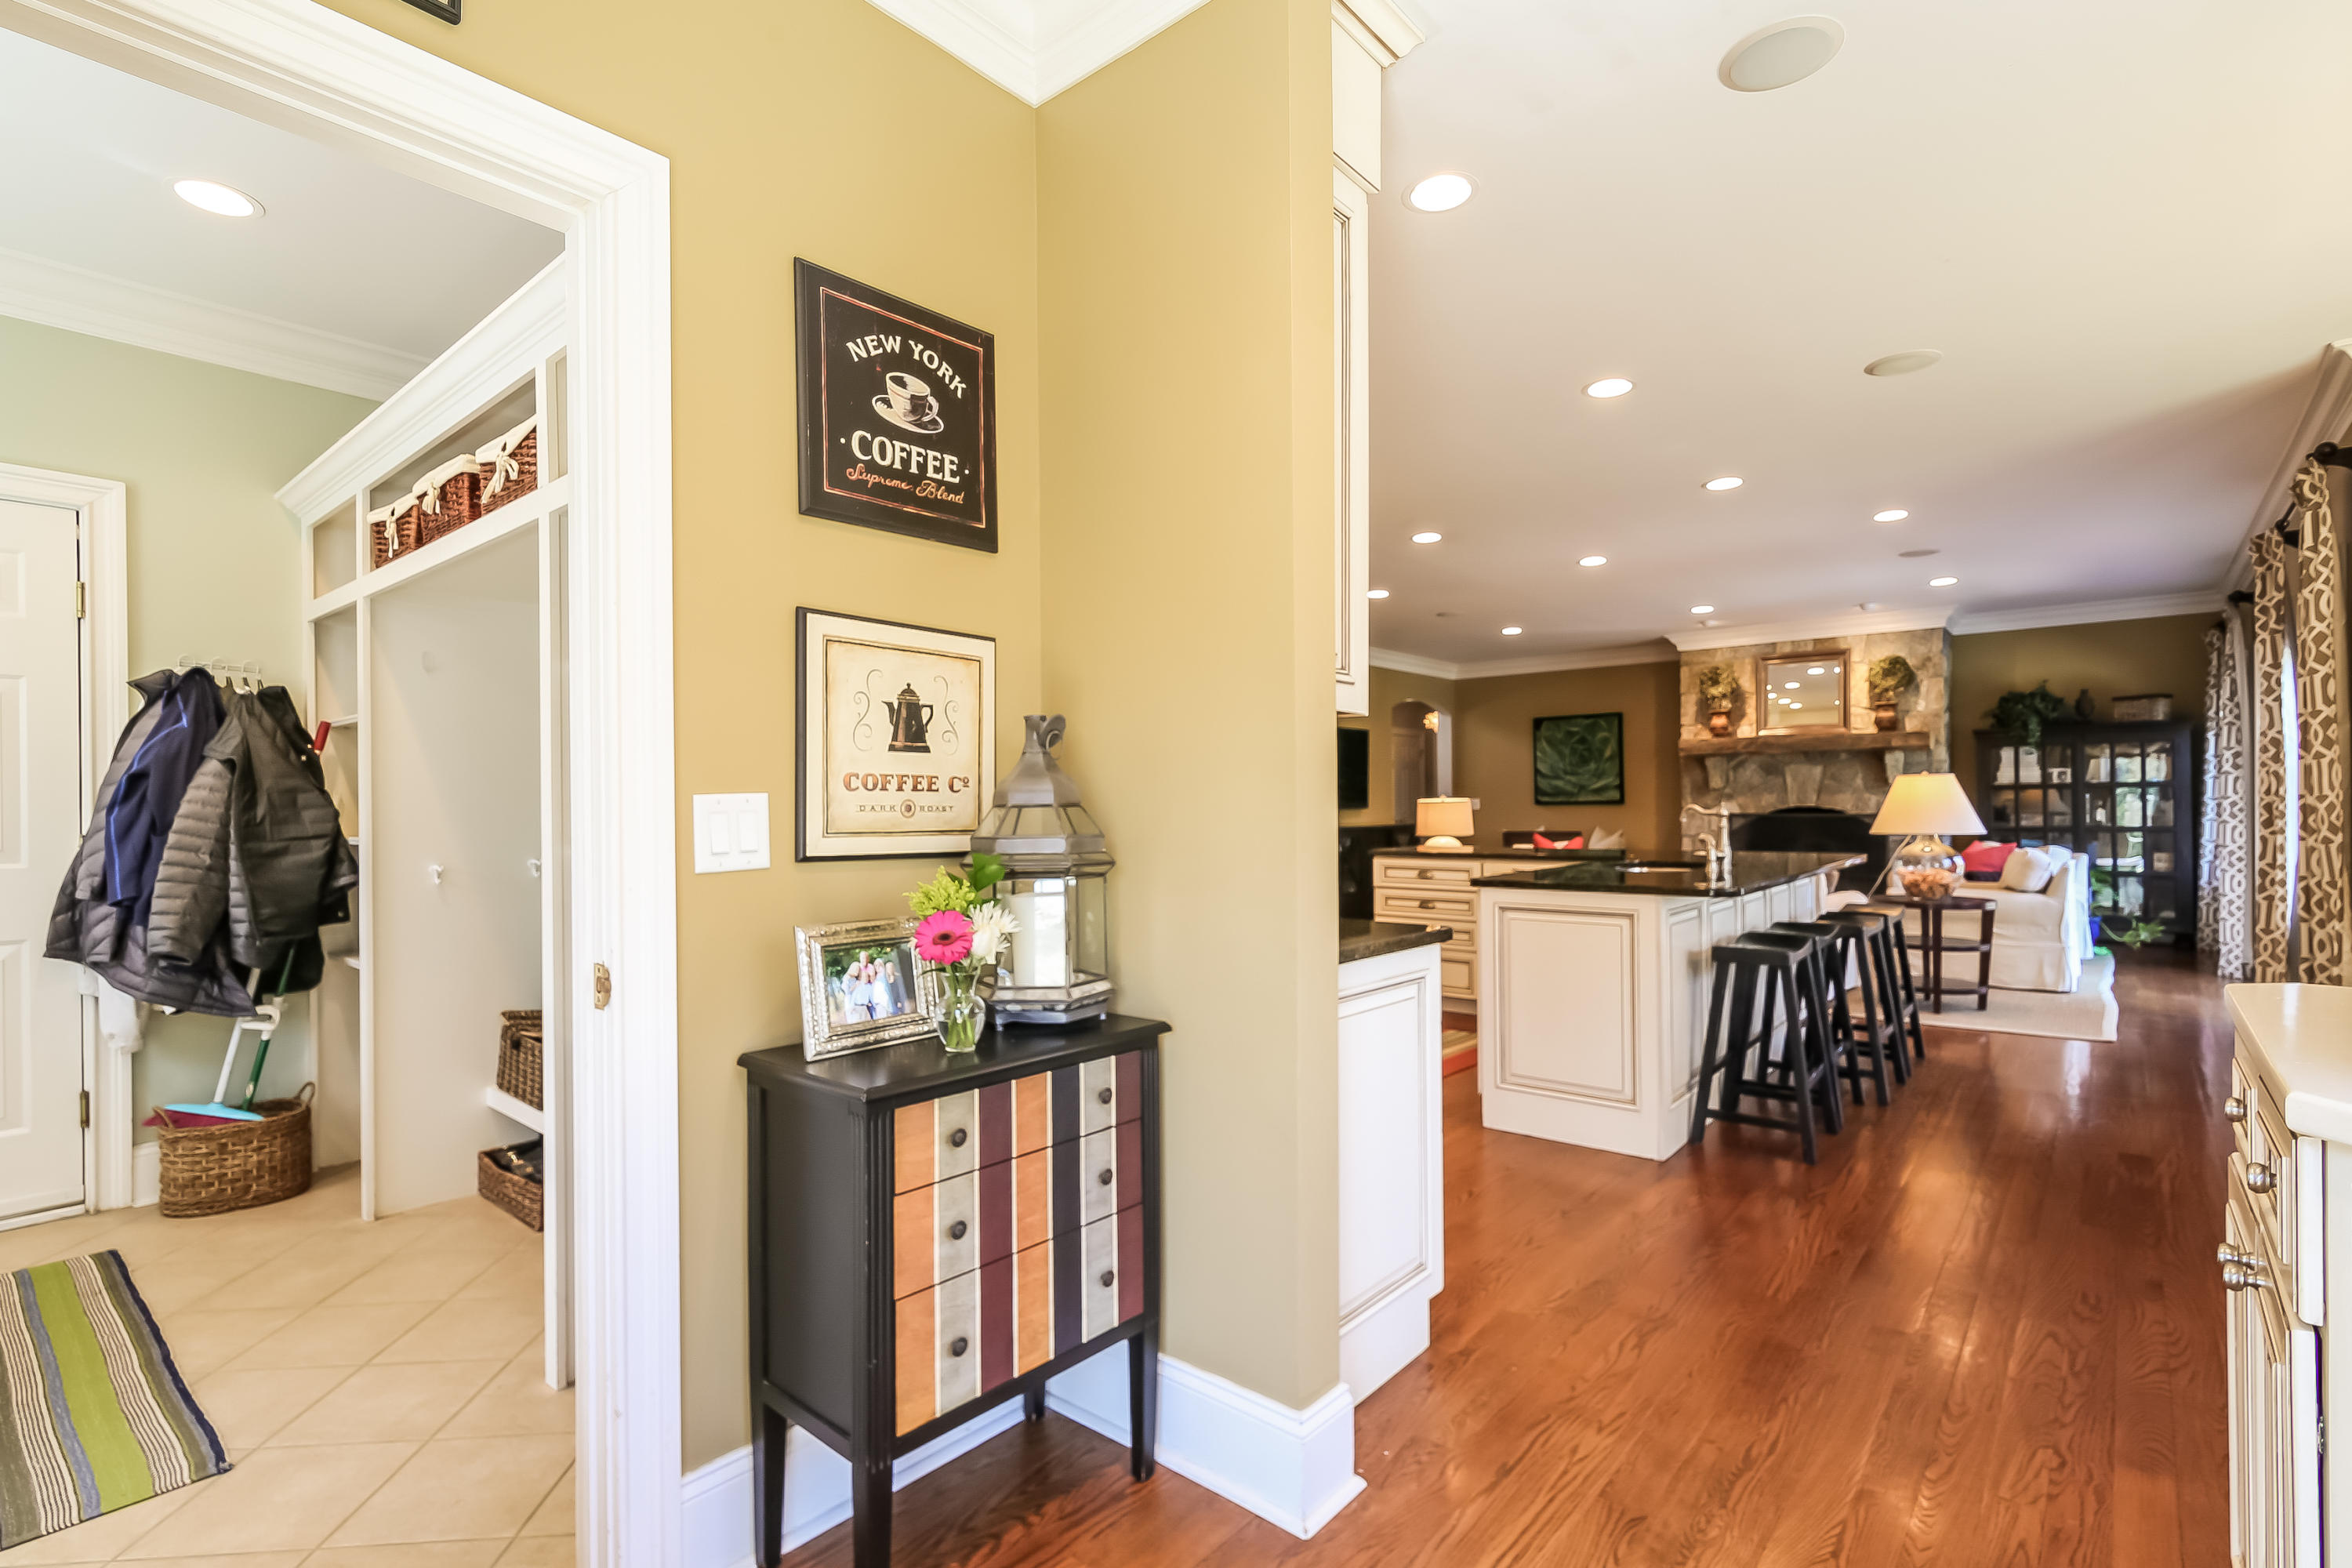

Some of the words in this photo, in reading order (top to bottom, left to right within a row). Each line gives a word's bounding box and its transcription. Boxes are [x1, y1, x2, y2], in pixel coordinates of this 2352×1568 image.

[846, 334, 902, 363] NEW
[909, 339, 967, 399] YORK
[851, 430, 960, 483] COFFEE
[916, 480, 964, 503] Blend
[843, 771, 939, 792] COFFEE
